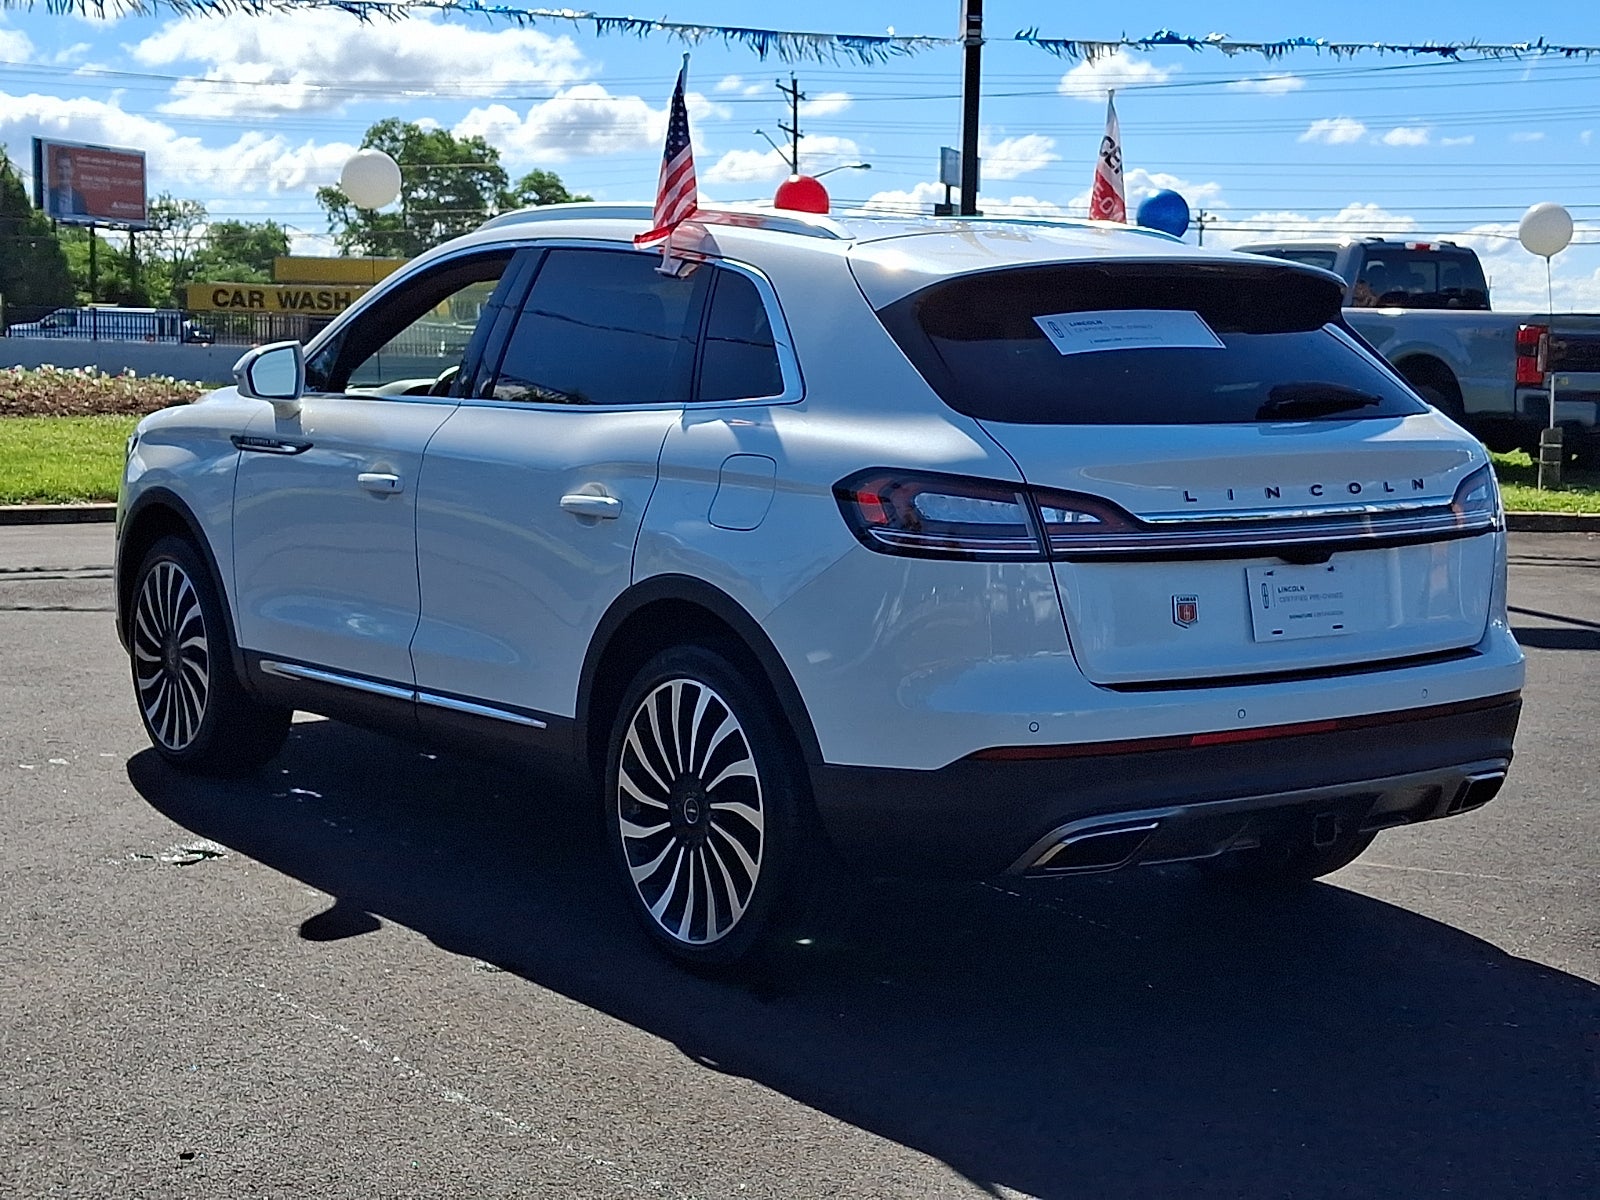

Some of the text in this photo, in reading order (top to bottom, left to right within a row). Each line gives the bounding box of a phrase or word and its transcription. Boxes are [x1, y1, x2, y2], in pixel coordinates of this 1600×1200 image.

[212, 288, 351, 310] CAR WASH
[1183, 478, 1425, 502] LINCOLN
[1278, 585, 1305, 593] LINCOLN
